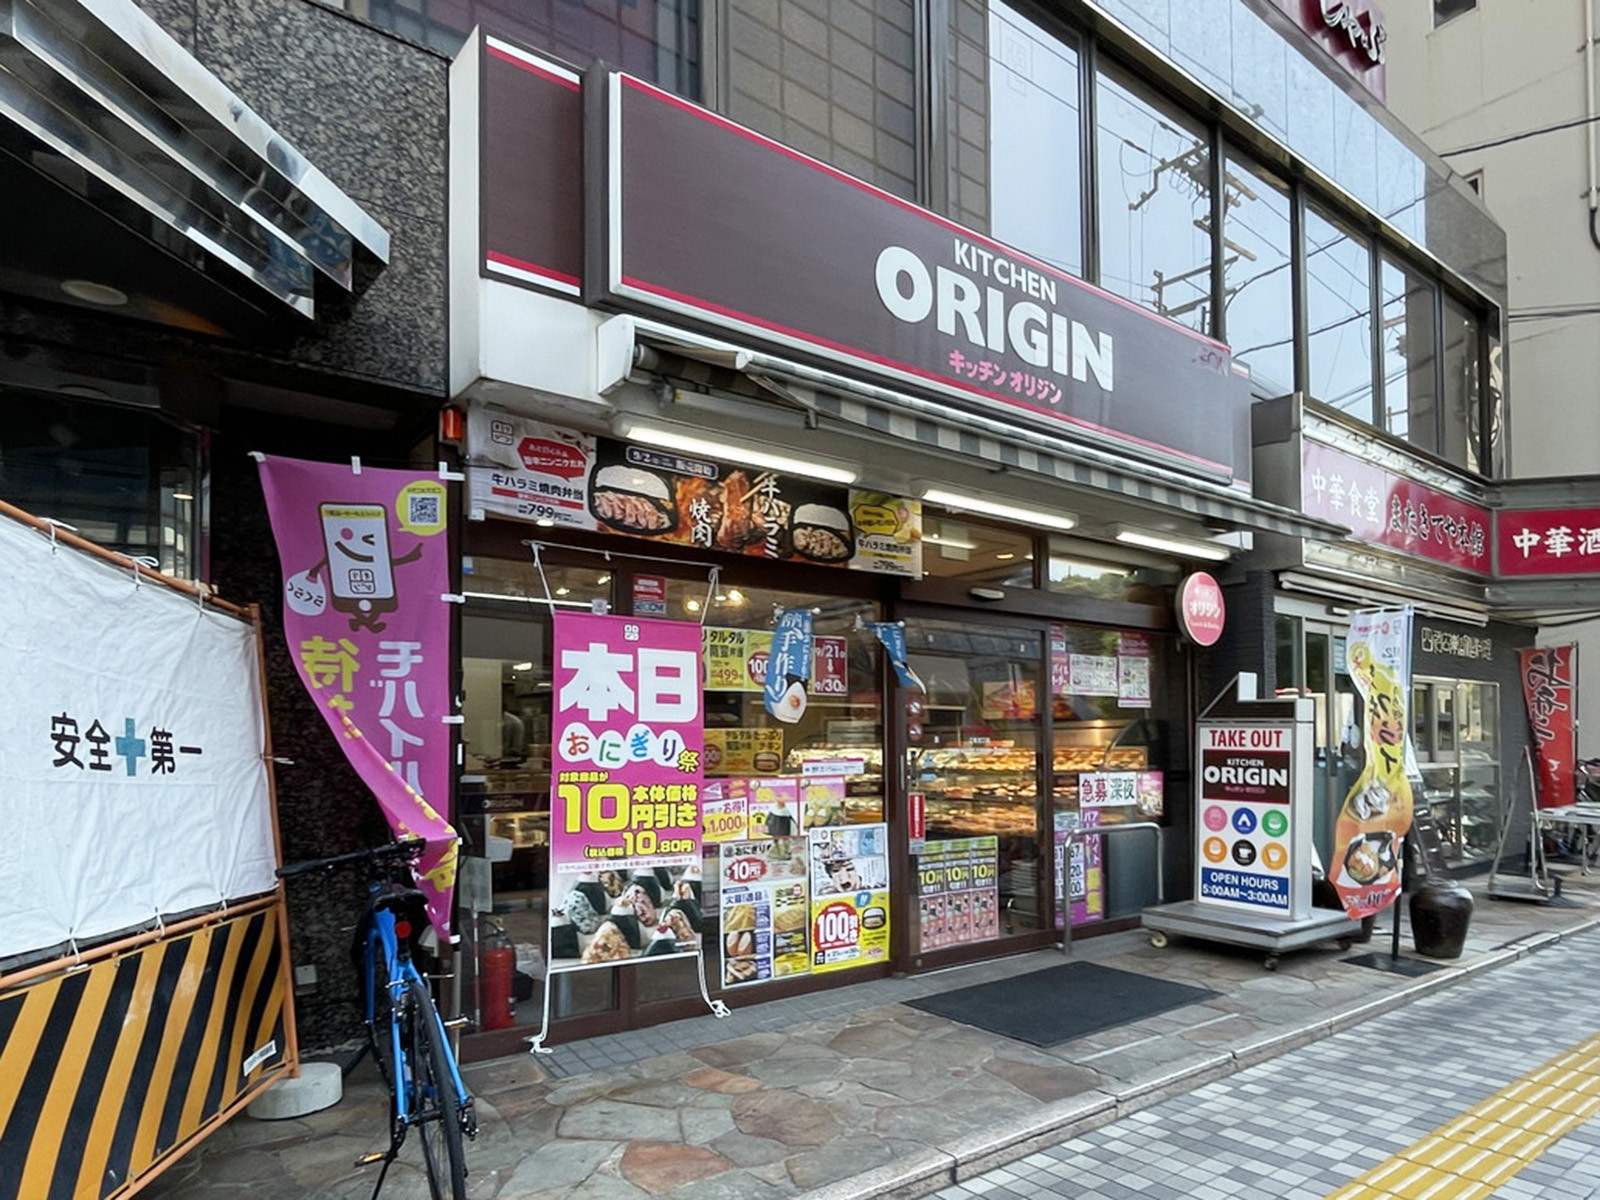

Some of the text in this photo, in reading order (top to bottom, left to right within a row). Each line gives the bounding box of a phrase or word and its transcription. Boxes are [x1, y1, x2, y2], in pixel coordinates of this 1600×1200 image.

[953, 238, 1057, 305] KITCHEN
[875, 246, 1113, 392] ORIGIN
[948, 349, 1063, 405] キッチン オリジン
[491, 473, 585, 501] 牛ハラミ焼肉弁当
[1310, 467, 1381, 524] 中華食堂
[690, 497, 722, 547] 焼肉
[760, 477, 782, 558] 牛ハラミ
[709, 630, 745, 645] タルタル
[559, 642, 699, 723] 本日
[50, 712, 202, 774] 安全 第一
[1209, 730, 1283, 748] TAKE OUT
[1204, 766, 1288, 787] ORIGIN
[1227, 758, 1264, 767] KITCHEN
[558, 784, 630, 834] 10
[632, 785, 698, 802] 本体価格
[1082, 777, 1135, 802] 急募 深夜
[631, 804, 698, 830] 円引き
[1210, 871, 1279, 890] OPEN HOURS
